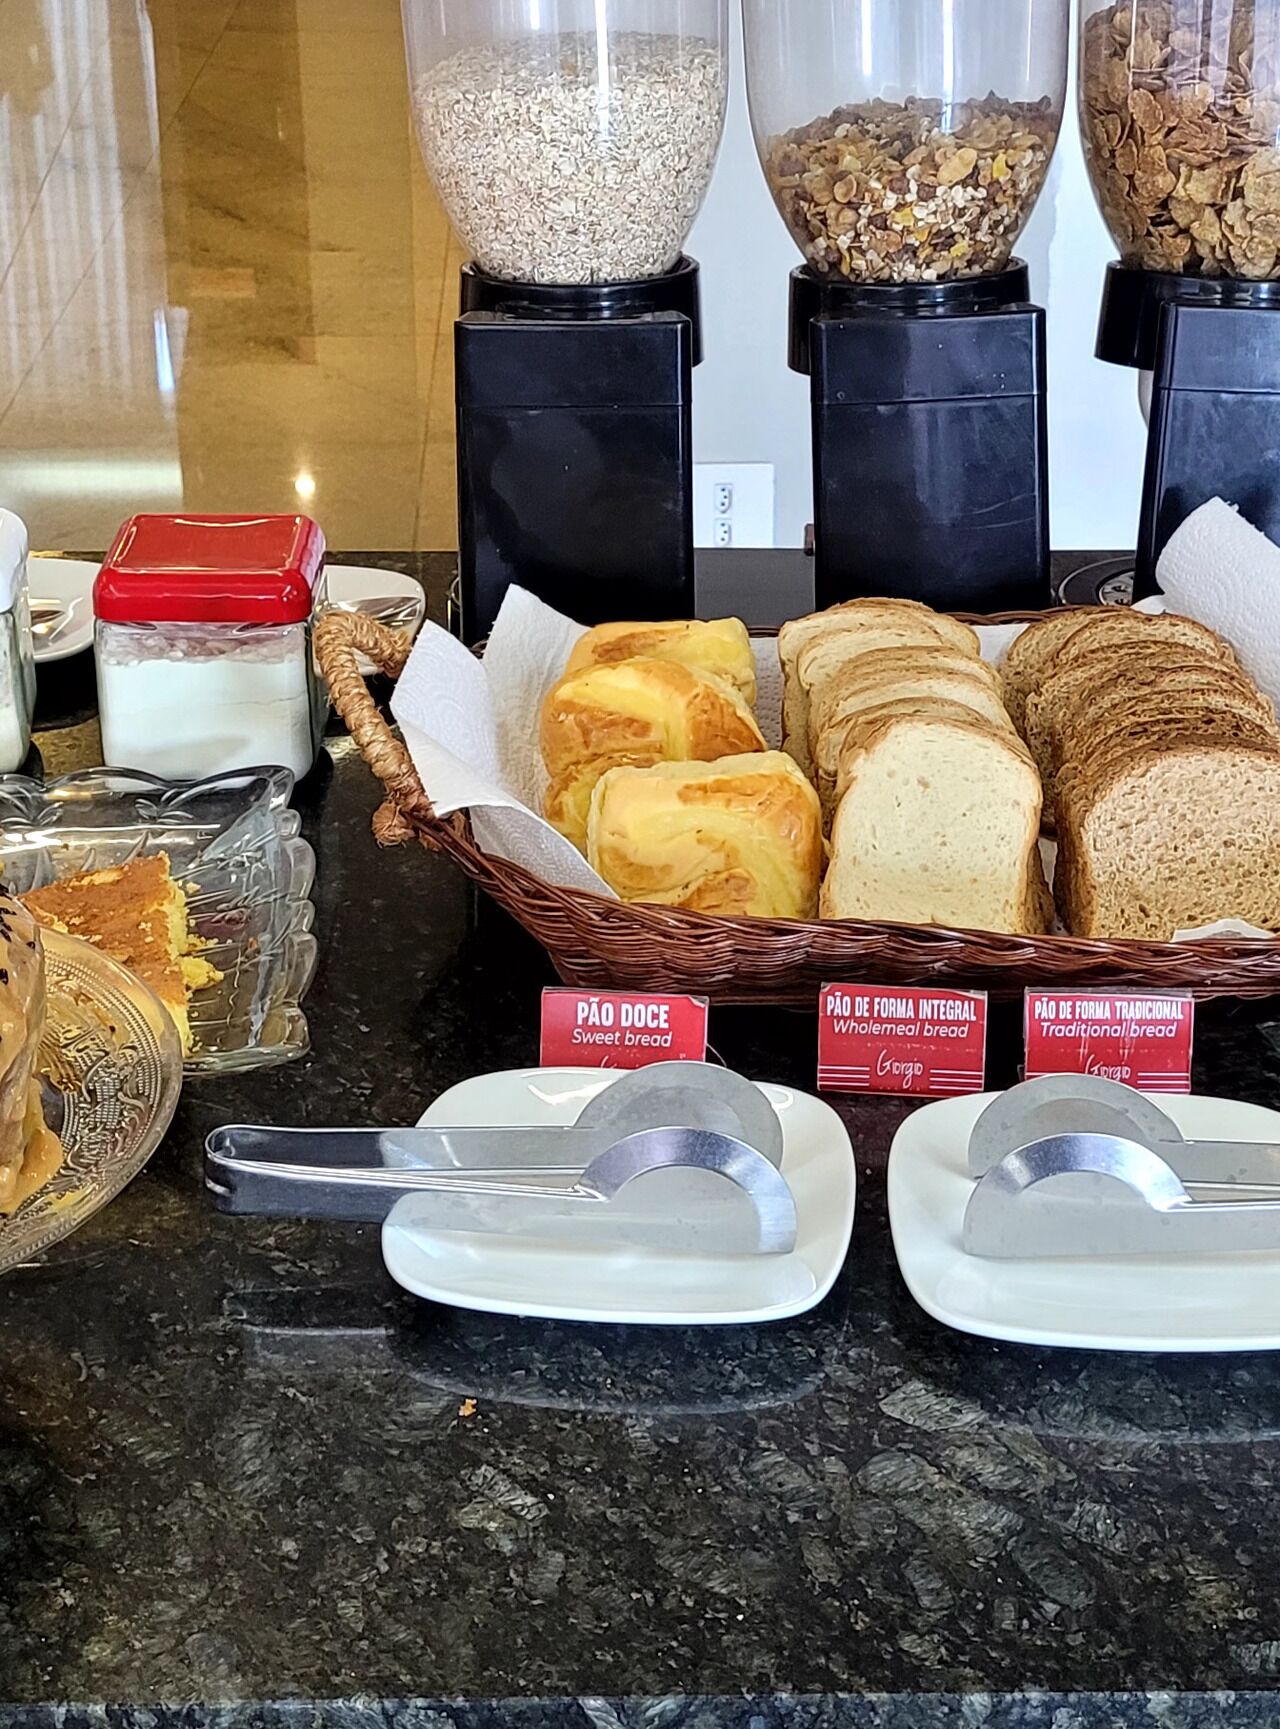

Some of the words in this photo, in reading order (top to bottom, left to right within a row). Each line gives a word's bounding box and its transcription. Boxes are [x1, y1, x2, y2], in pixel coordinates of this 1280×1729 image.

[577, 997, 614, 1027] PÃO
[621, 1003, 669, 1028] DOCE
[826, 992, 851, 1017] PÃO
[855, 996, 869, 1017] DE
[874, 997, 914, 1019] FORMA
[920, 999, 976, 1021] INTEGRAL
[1035, 997, 1056, 1019] PÃO
[1059, 1001, 1071, 1019] DE
[1075, 1001, 1111, 1019] FORMA
[1115, 1001, 1184, 1020] TRADICIONAL
[572, 1028, 620, 1045] Sweet
[625, 1030, 672, 1047] bread
[833, 1019, 920, 1036] Wholemeal
[923, 1022, 969, 1038] bread
[1041, 1021, 1126, 1037] Traditional
[1130, 1022, 1177, 1038] bread
[877, 1049, 923, 1089] Giorgio
